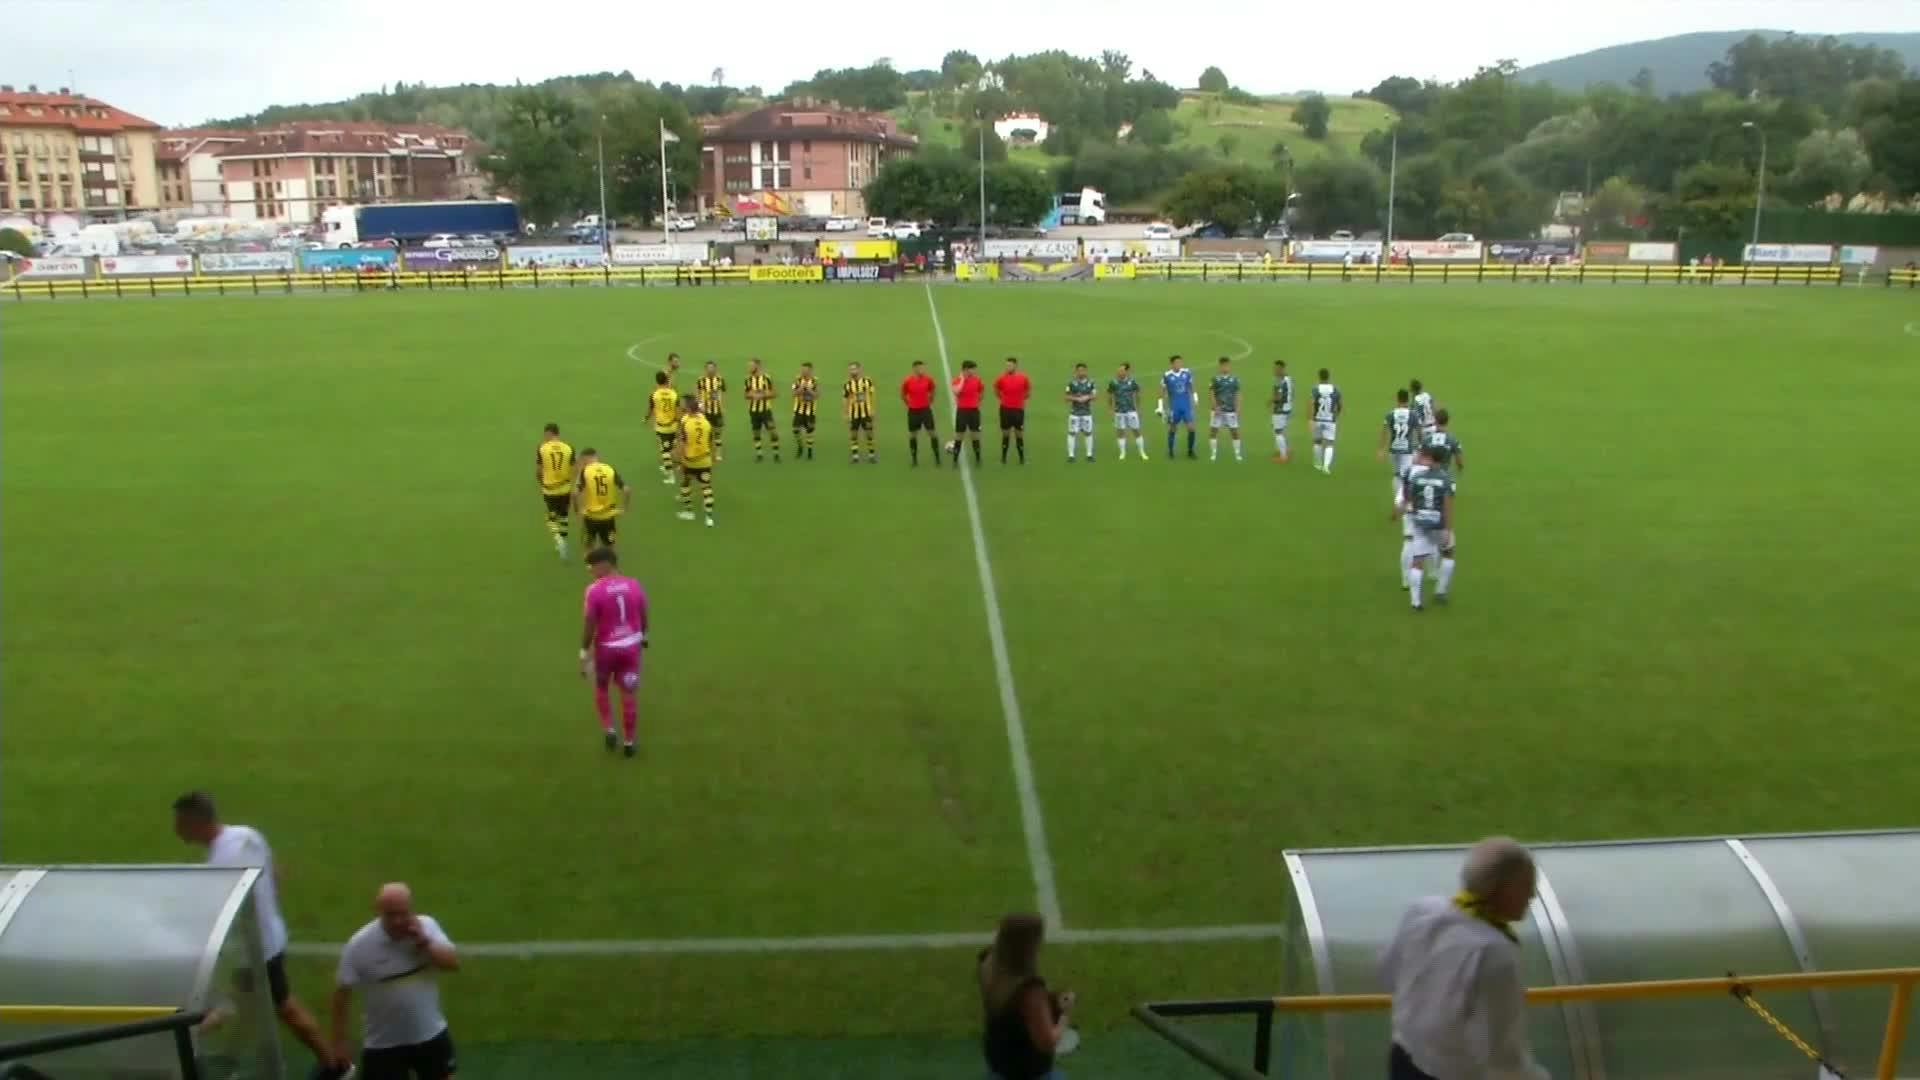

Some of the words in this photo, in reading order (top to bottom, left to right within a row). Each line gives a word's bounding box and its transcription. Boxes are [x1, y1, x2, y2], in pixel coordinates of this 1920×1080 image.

[550, 452, 563, 471] 17
[594, 475, 608, 497] 15
[616, 594, 626, 623] 1
